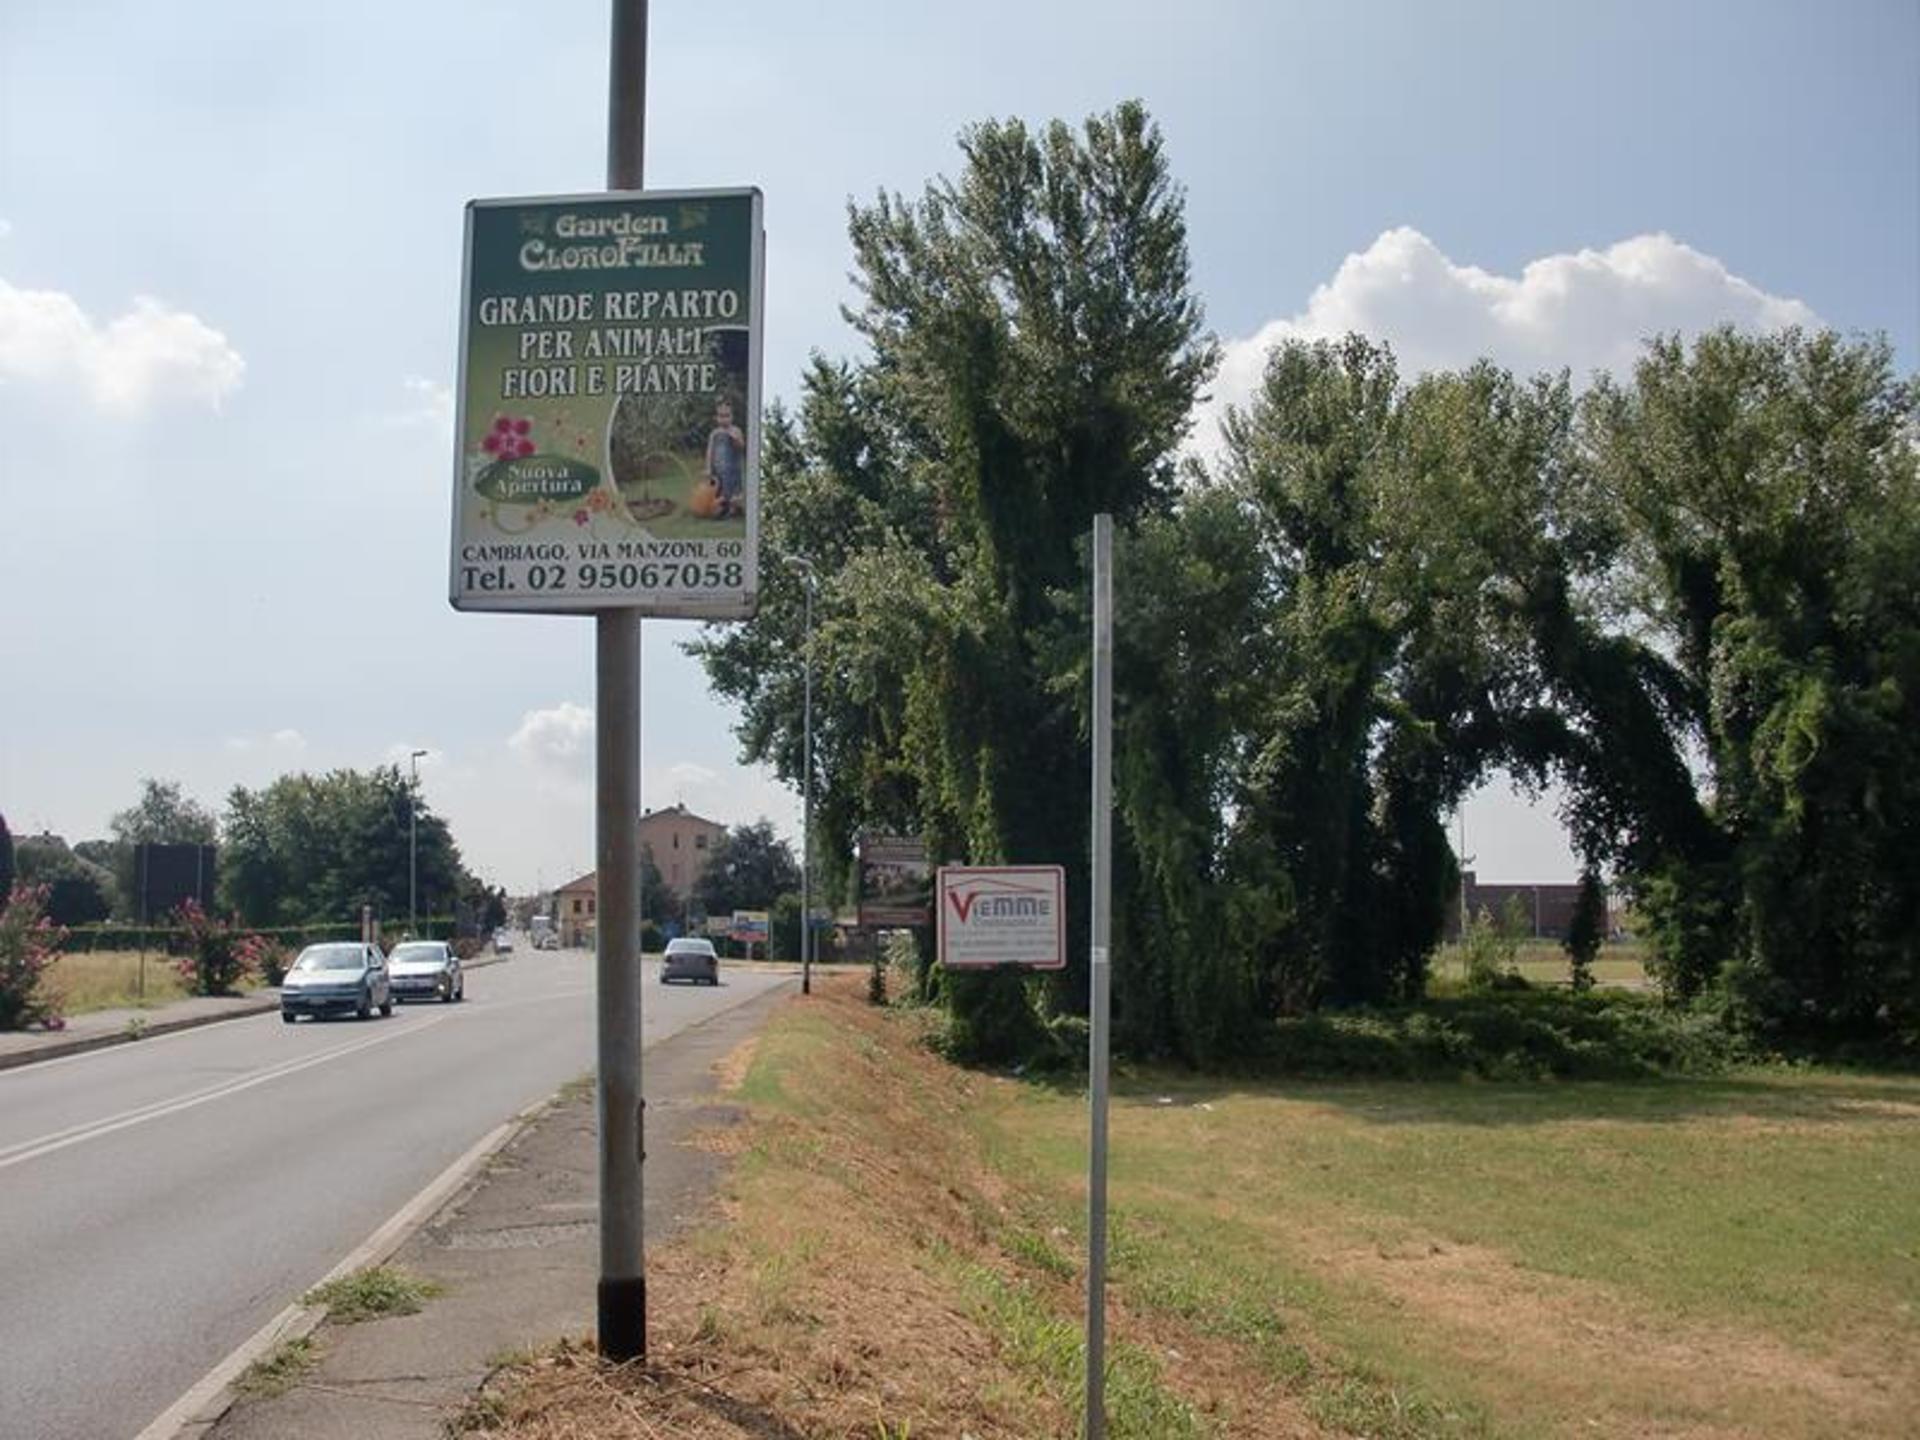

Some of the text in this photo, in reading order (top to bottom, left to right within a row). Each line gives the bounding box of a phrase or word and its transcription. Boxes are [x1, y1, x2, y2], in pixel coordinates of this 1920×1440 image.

[556, 213, 669, 238] Garden
[479, 289, 738, 325] GRANDE REPARTO
[520, 326, 703, 359] PER ANIMALI
[504, 363, 717, 397] FIORI E PIANTE
[508, 464, 568, 478] Nuova
[497, 479, 583, 497] Apertura
[578, 543, 610, 559] VIA
[717, 542, 742, 558] 60
[462, 563, 743, 591] Tel. 02 95067058
